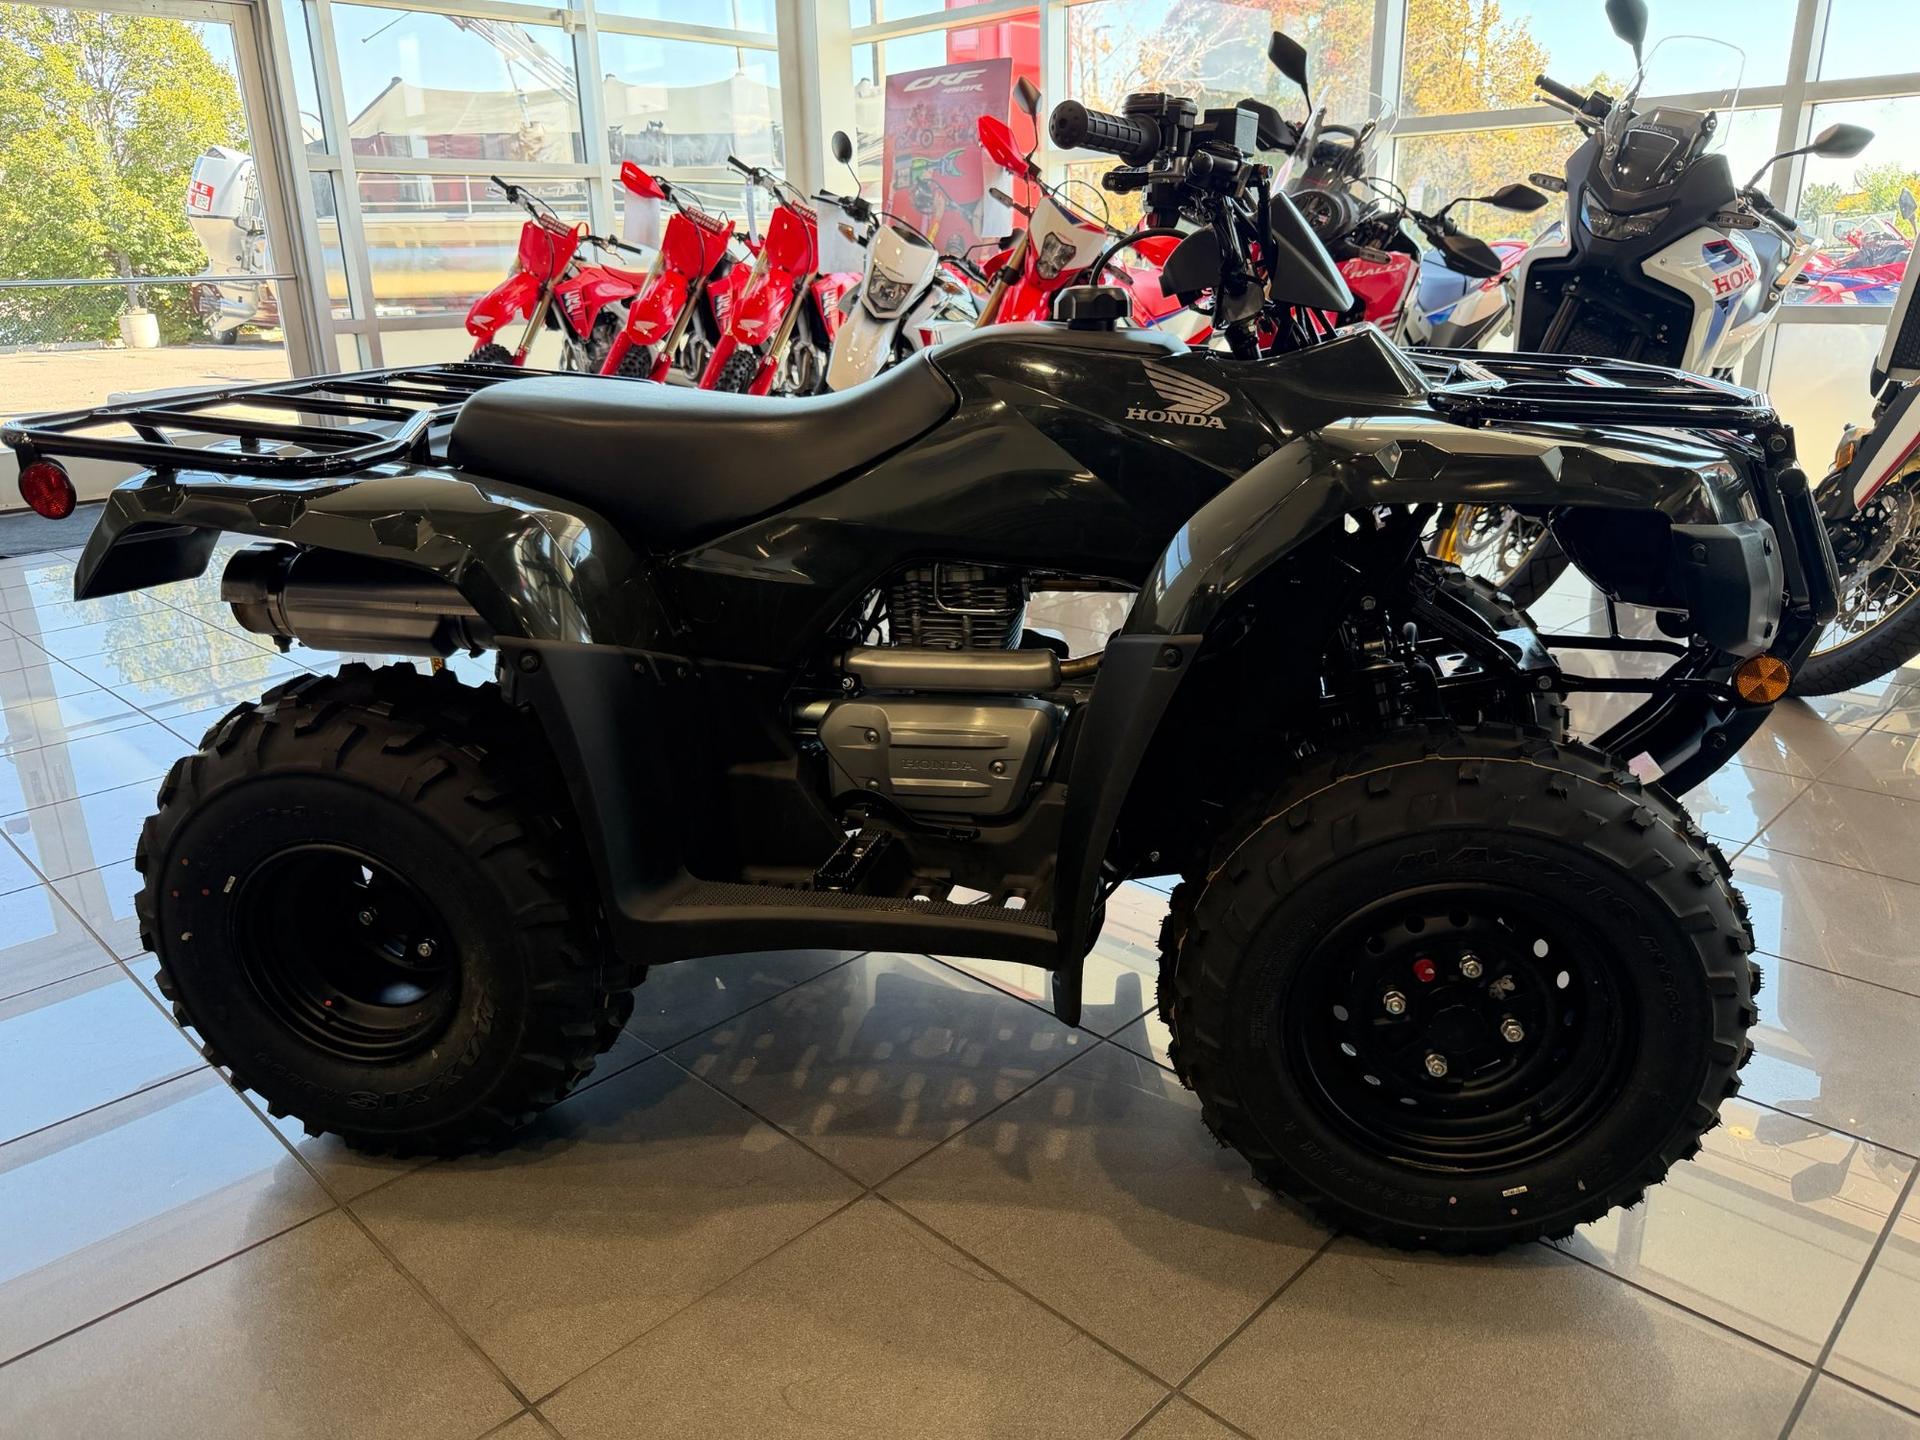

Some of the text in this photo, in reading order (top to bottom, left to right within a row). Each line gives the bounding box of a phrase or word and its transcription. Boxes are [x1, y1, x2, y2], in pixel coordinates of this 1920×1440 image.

[903, 68, 988, 92] CRF
[1349, 262, 1407, 279] RALLY
[1712, 263, 1755, 295] HON
[1124, 407, 1228, 430] HONDA
[901, 758, 979, 772] HONDA
